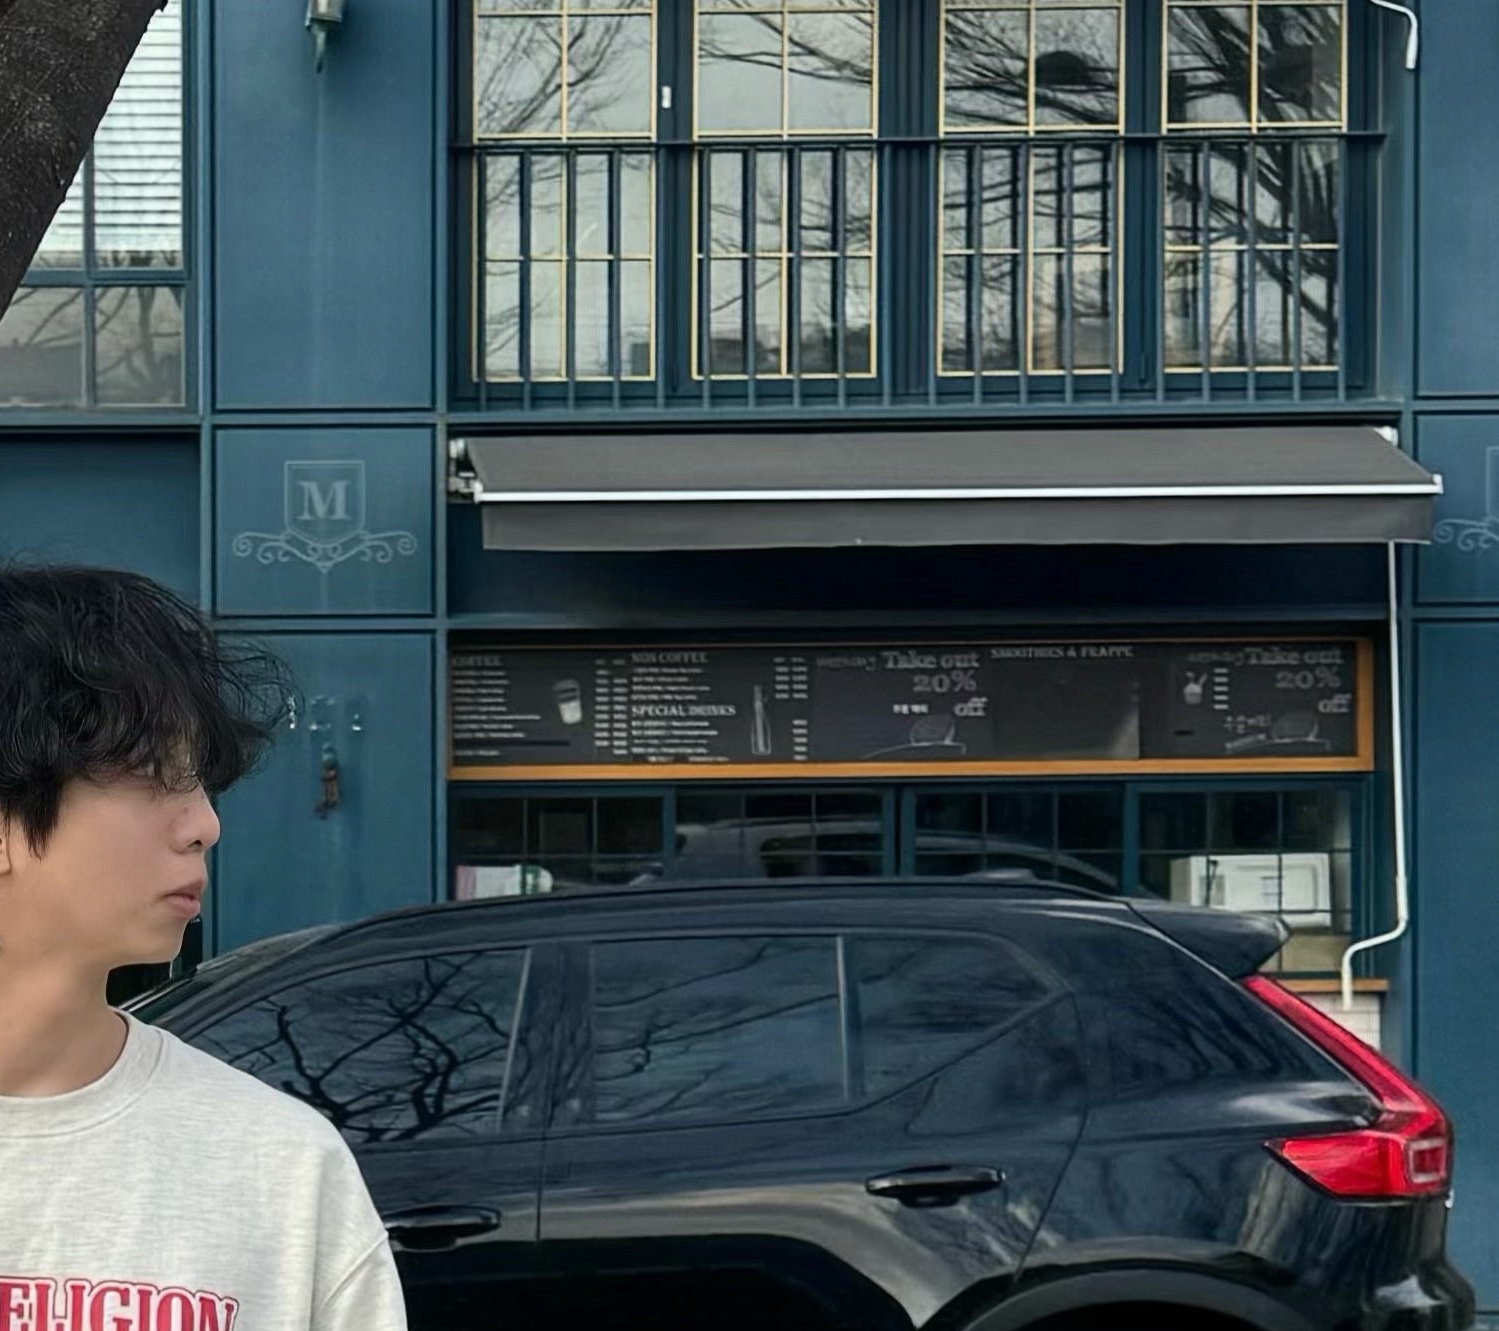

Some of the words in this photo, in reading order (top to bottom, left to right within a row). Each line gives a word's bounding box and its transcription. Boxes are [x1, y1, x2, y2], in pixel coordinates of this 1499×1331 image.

[295, 480, 353, 521] M
[881, 650, 937, 669] Take
[940, 652, 980, 668] out
[1244, 647, 1300, 665] Take
[1303, 648, 1344, 664] out
[912, 669, 977, 693] 20%
[1275, 666, 1342, 690] 20%
[631, 704, 686, 717] SPECIAL
[688, 704, 737, 717] DRINKS
[953, 697, 988, 717] off
[1317, 693, 1352, 713] off
